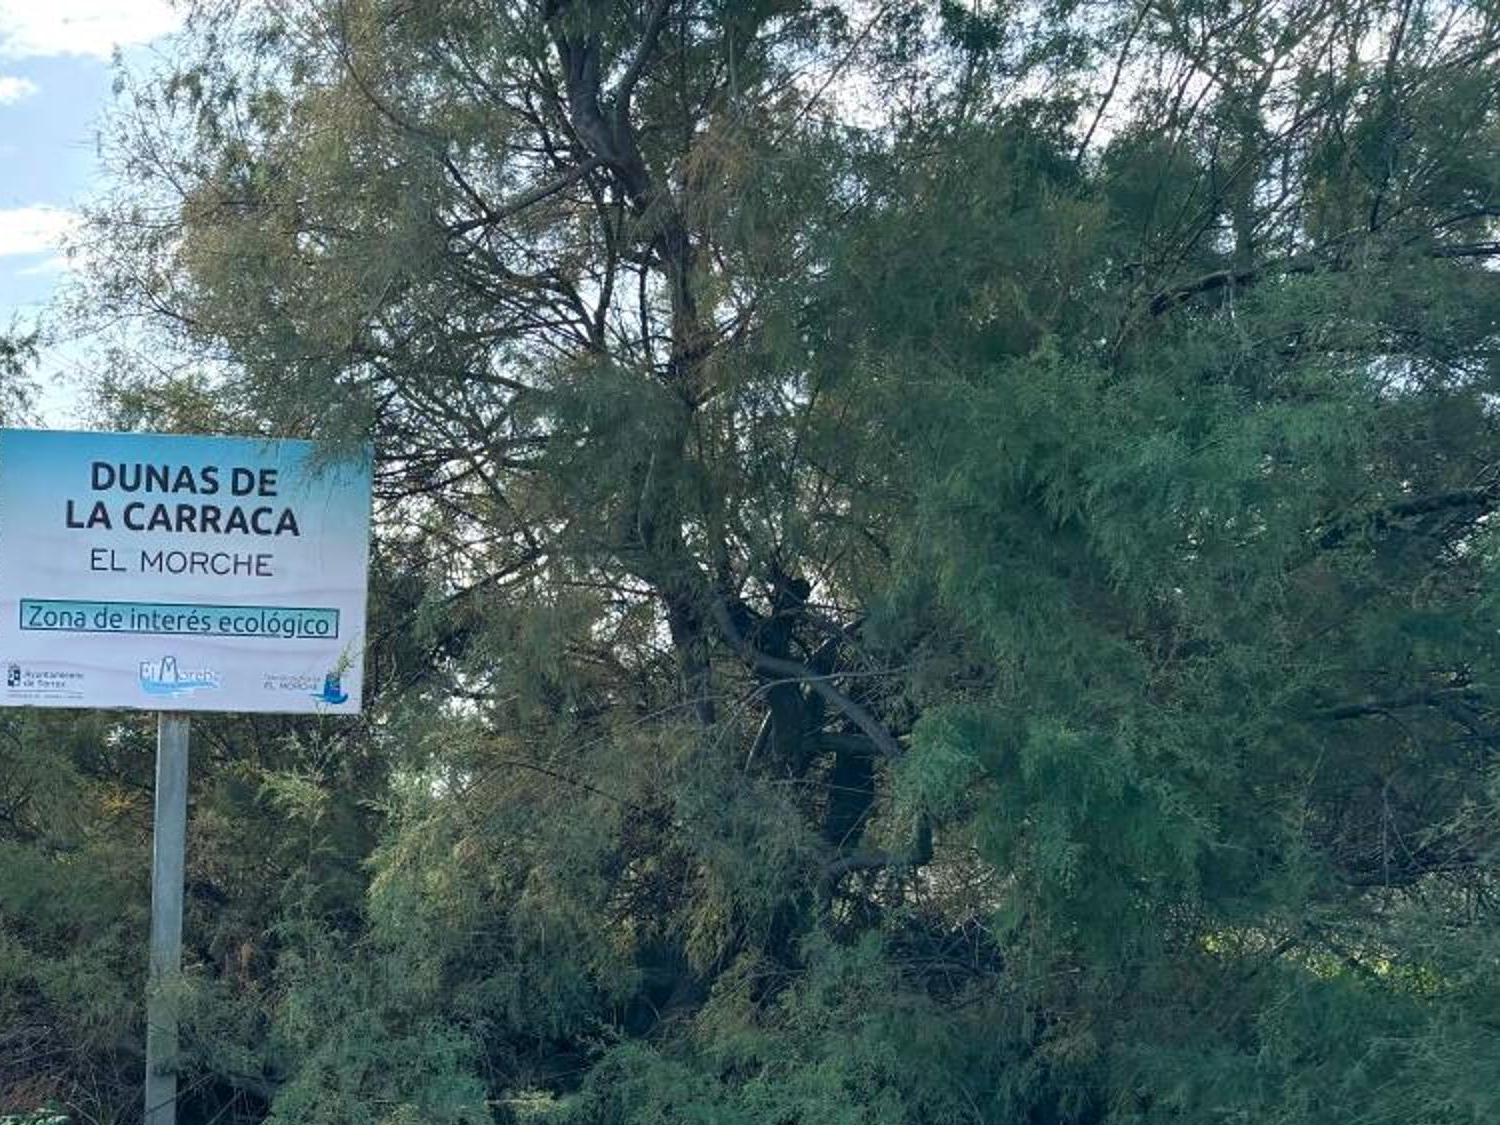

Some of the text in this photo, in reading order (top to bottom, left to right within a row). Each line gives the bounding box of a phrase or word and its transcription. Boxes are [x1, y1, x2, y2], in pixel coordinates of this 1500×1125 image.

[91, 461, 278, 497] DUNAS DE
[66, 500, 301, 537] LA CARRACA
[91, 548, 274, 577] EL MORCHE
[29, 604, 329, 639] Zona de interés ecológico
